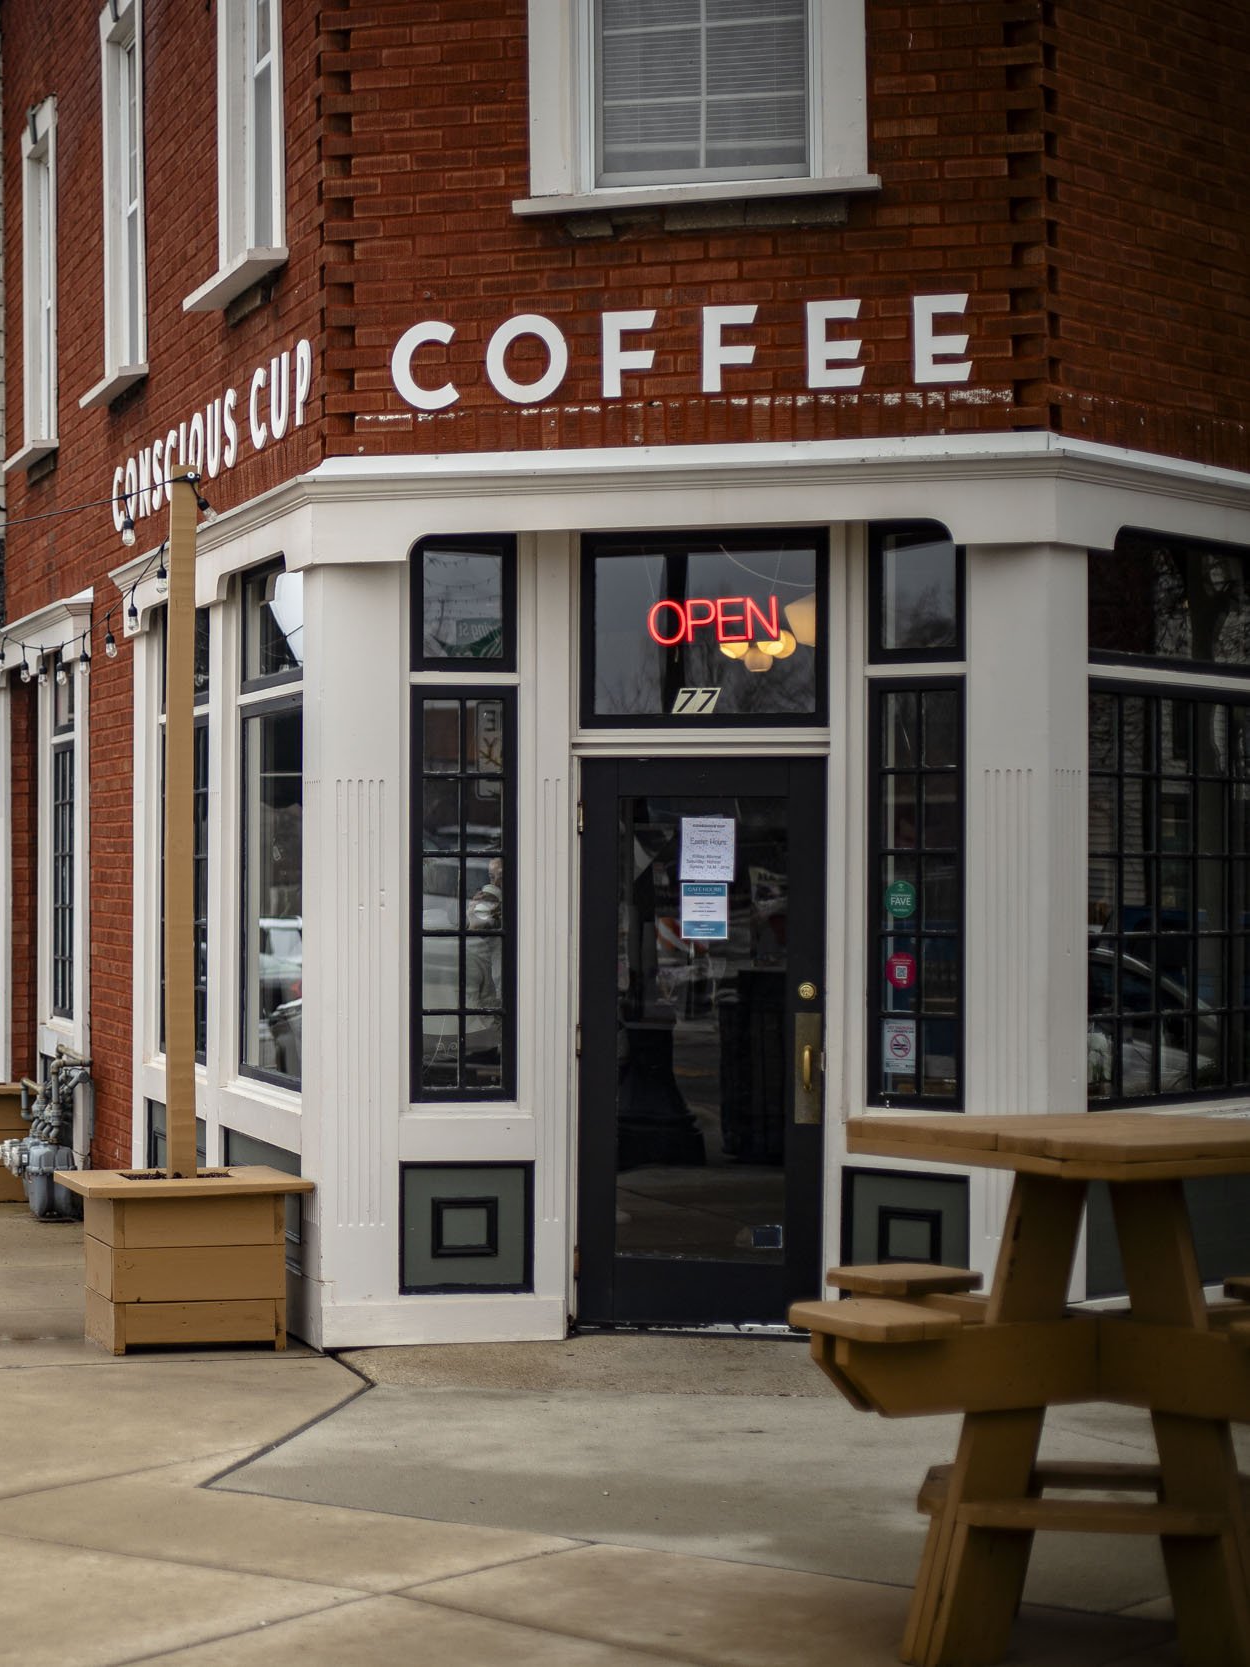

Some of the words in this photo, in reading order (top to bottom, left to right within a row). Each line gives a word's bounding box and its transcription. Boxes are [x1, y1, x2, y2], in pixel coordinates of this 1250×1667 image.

[390, 293, 973, 410] COFFEE
[111, 388, 238, 532] CONSCIOUS
[249, 338, 312, 450] CUP
[647, 595, 780, 647] OPEN
[676, 689, 719, 713] 77
[890, 897, 912, 906] FAVE
